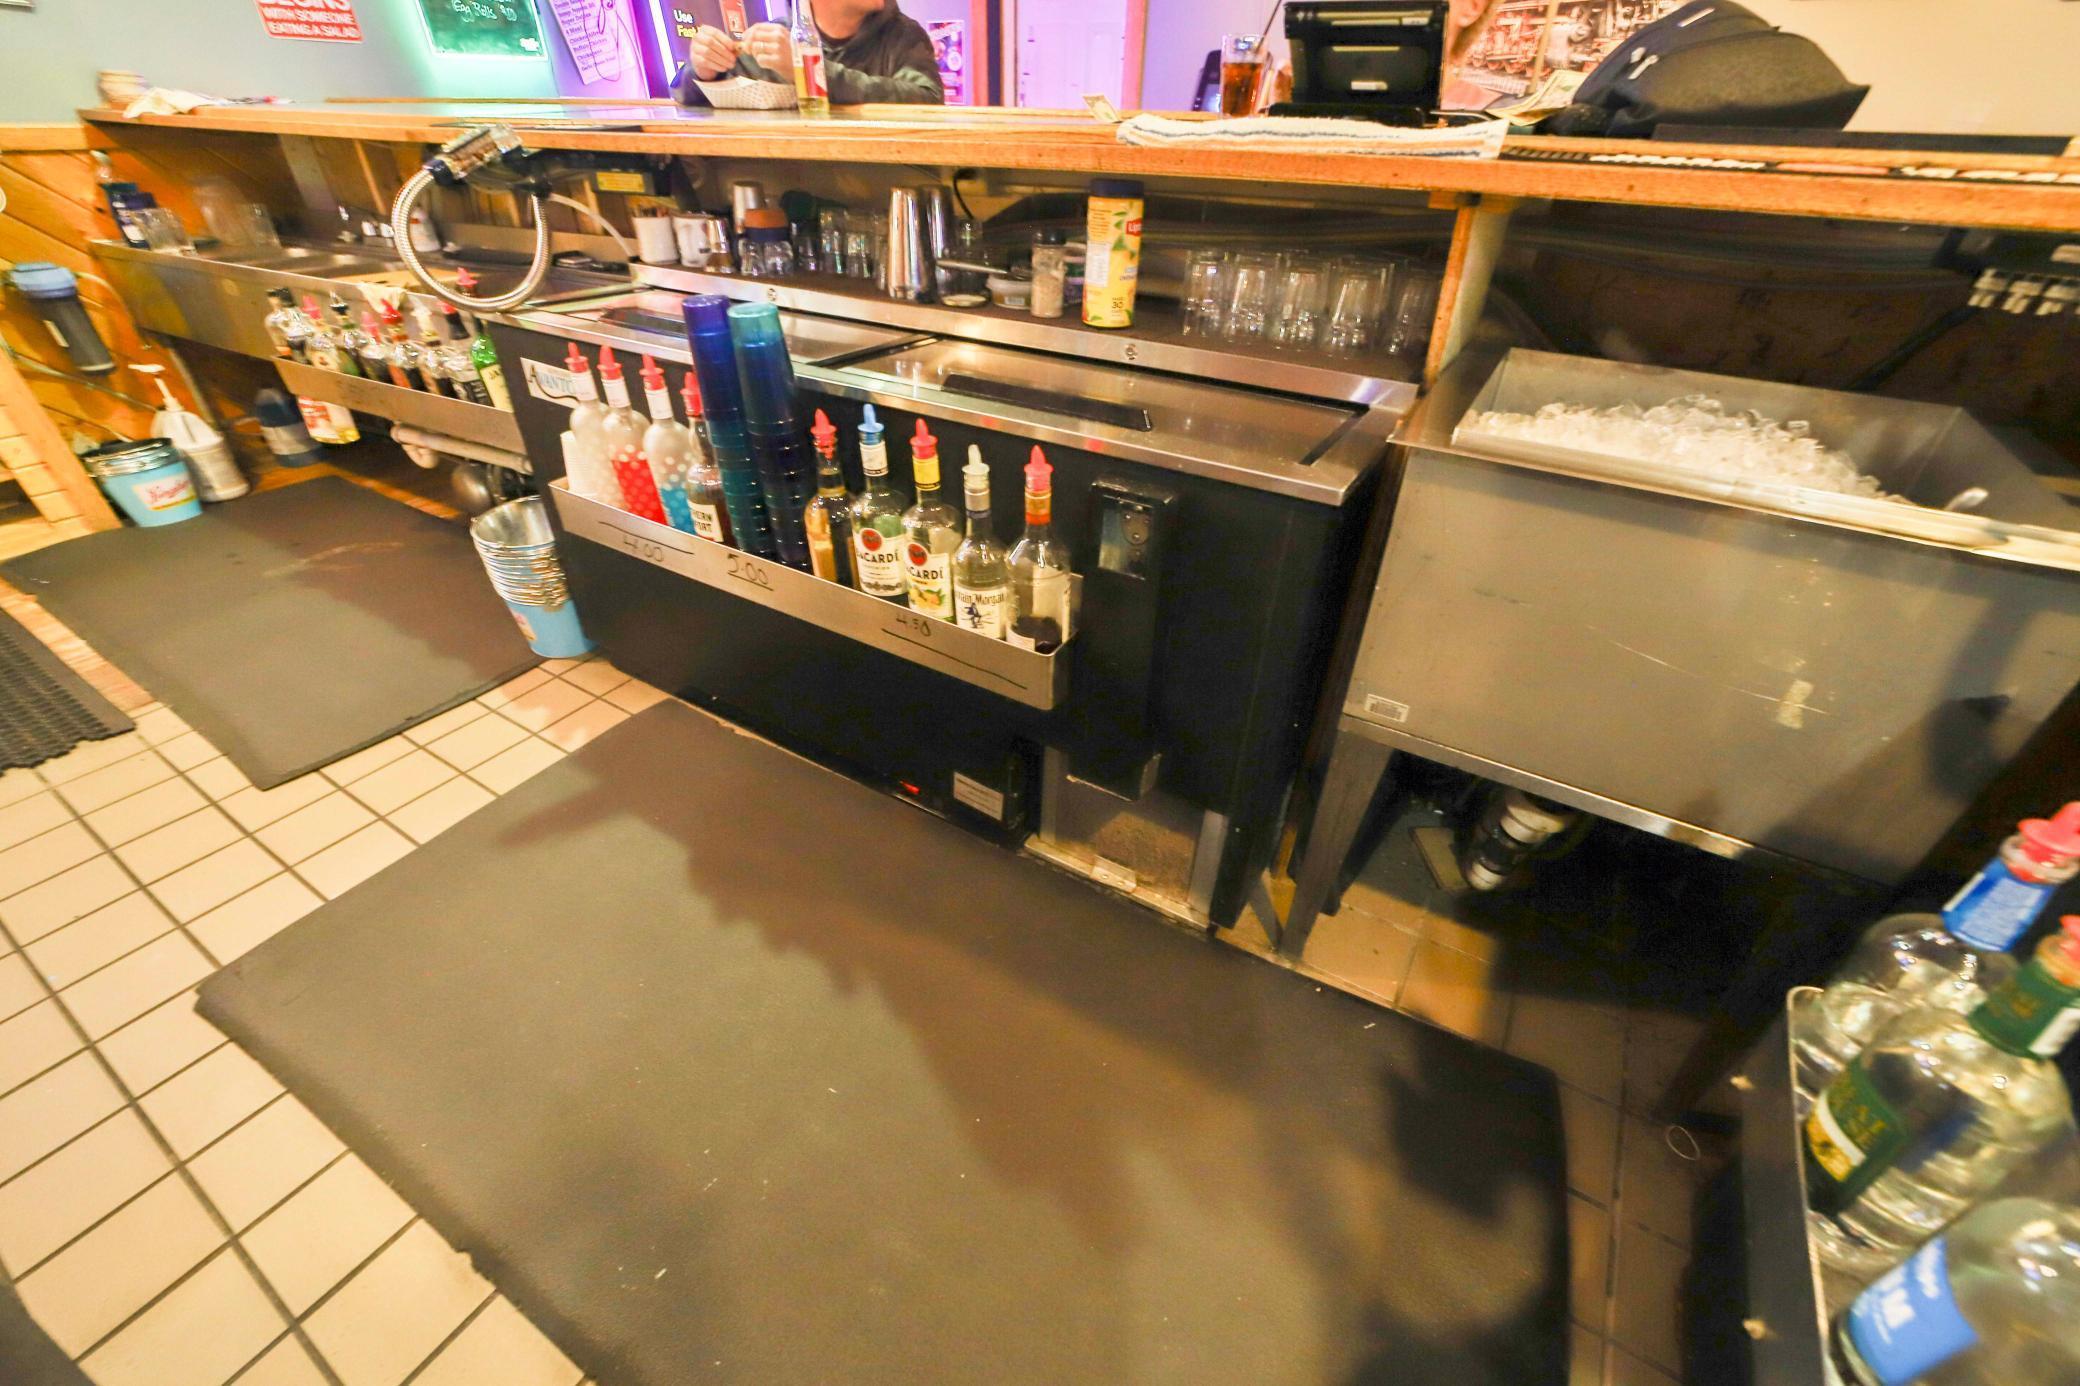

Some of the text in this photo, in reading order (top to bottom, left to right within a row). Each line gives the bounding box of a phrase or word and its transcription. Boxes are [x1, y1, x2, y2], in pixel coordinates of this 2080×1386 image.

[293, 9, 355, 24] SOMEONE
[673, 9, 694, 24] Use
[320, 25, 361, 38] SALAD
[857, 548, 900, 563] ACARDÍ
[727, 553, 769, 585] 5.00
[906, 565, 944, 580] CARDÍ
